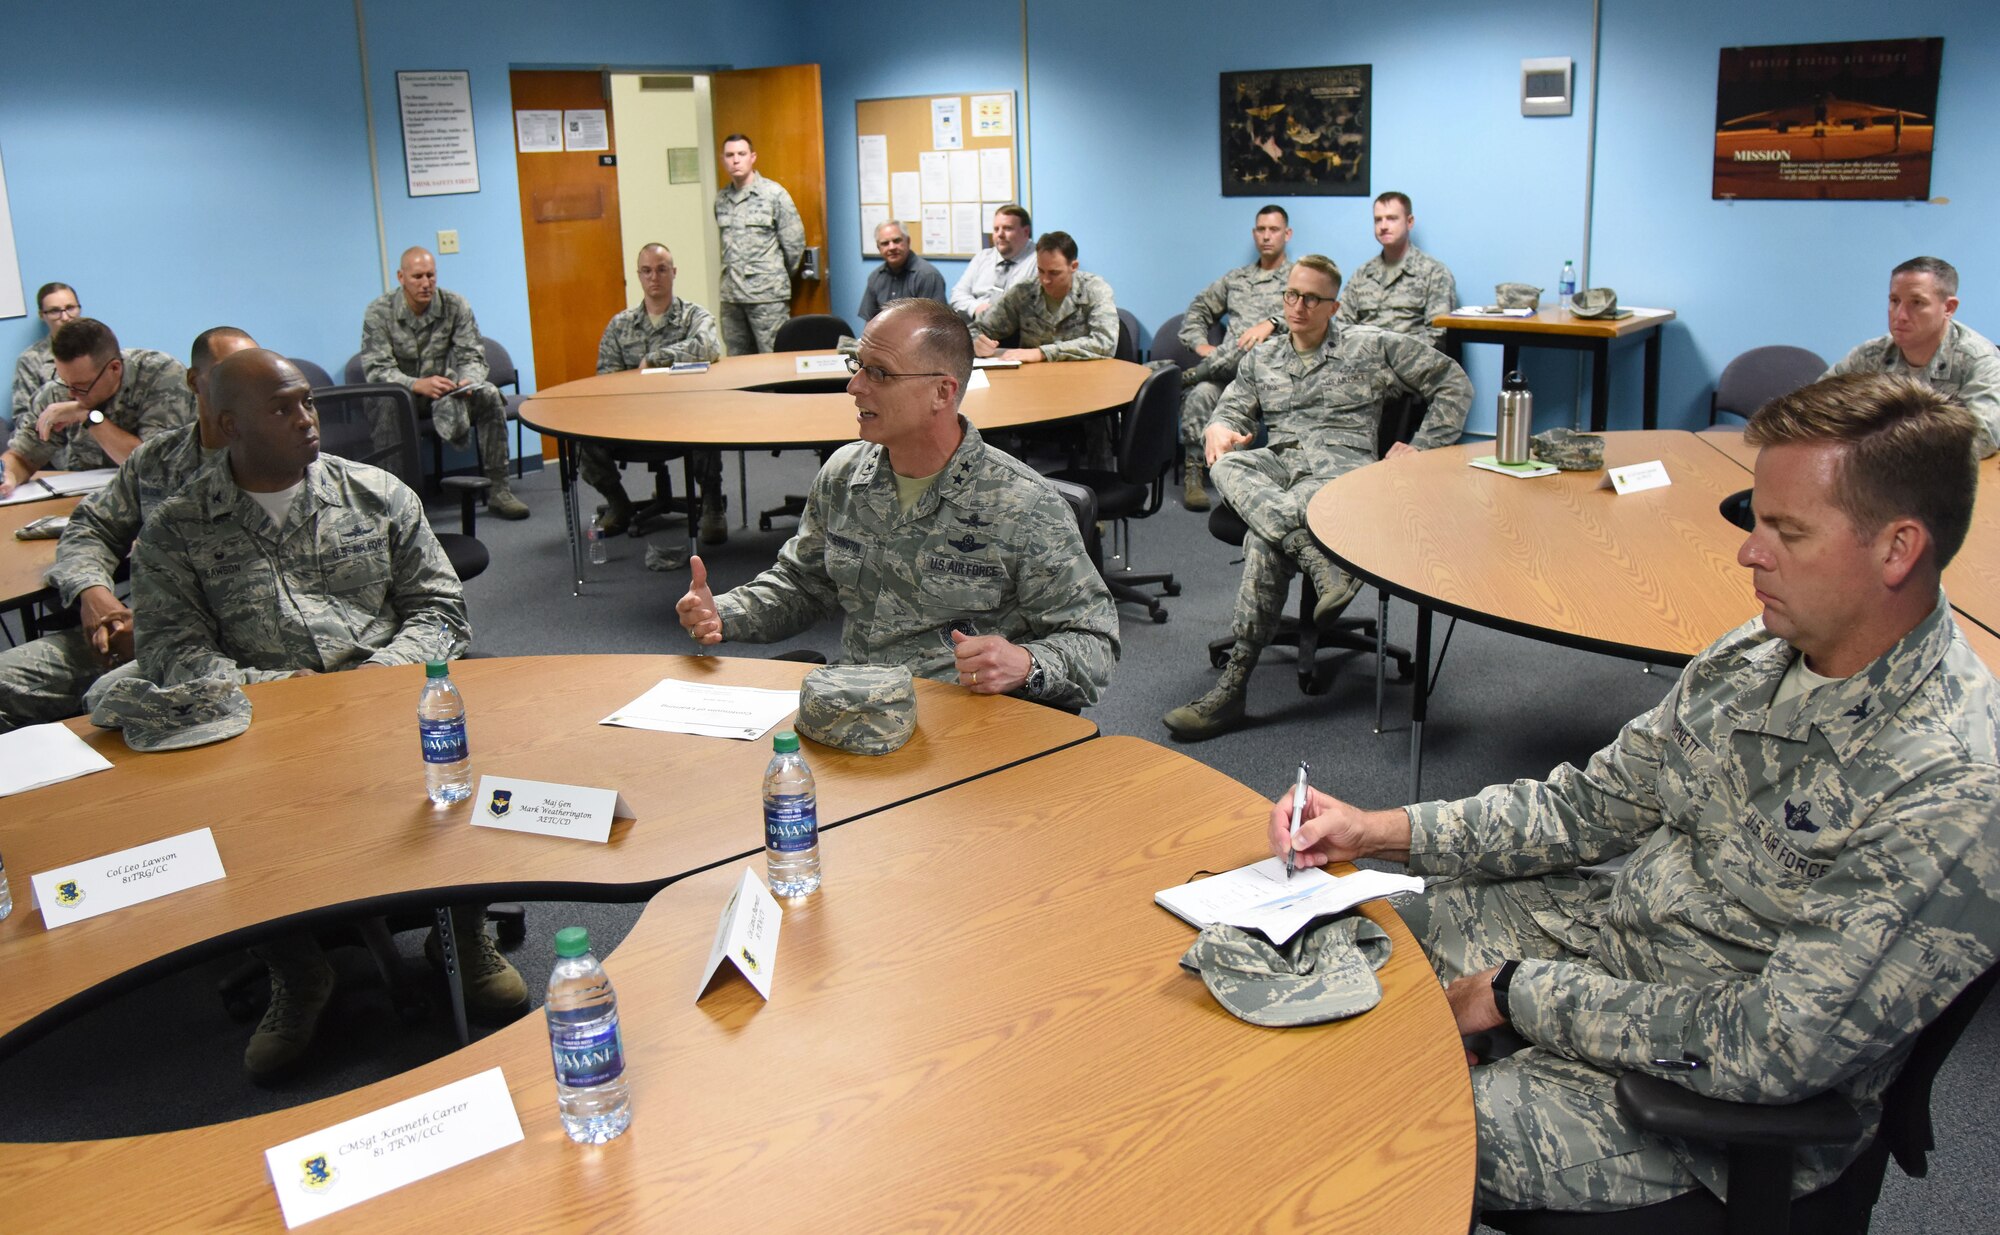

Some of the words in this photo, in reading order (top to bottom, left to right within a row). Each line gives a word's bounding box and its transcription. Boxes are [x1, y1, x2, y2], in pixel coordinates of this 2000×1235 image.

[1734, 150, 1791, 161] MISSION
[930, 558, 946, 572] U.S.
[949, 562, 965, 574] AIR
[966, 564, 998, 577] FORCE
[424, 737, 461, 752] DASANI
[520, 805, 539, 813] Mark
[541, 806, 592, 819] Weatherington
[543, 798, 557, 808] Maj
[558, 800, 572, 808] Gen
[537, 816, 571, 825] AETC/CD
[769, 823, 812, 838] DASANI
[1744, 811, 1765, 838] U.S.
[1763, 832, 1780, 855] AIR
[1777, 846, 1831, 878] FORCE
[106, 866, 122, 878] Col
[124, 863, 140, 873] Leo
[142, 853, 177, 868] Lawson
[122, 864, 168, 884] 81TRG/CC
[554, 1048, 610, 1070] DASANI
[338, 1135, 377, 1156] CMSgt
[381, 1113, 430, 1141] Kenneth
[433, 1101, 469, 1121] Carter
[373, 1147, 384, 1158] 81
[387, 1122, 445, 1152] TRW/CCC
